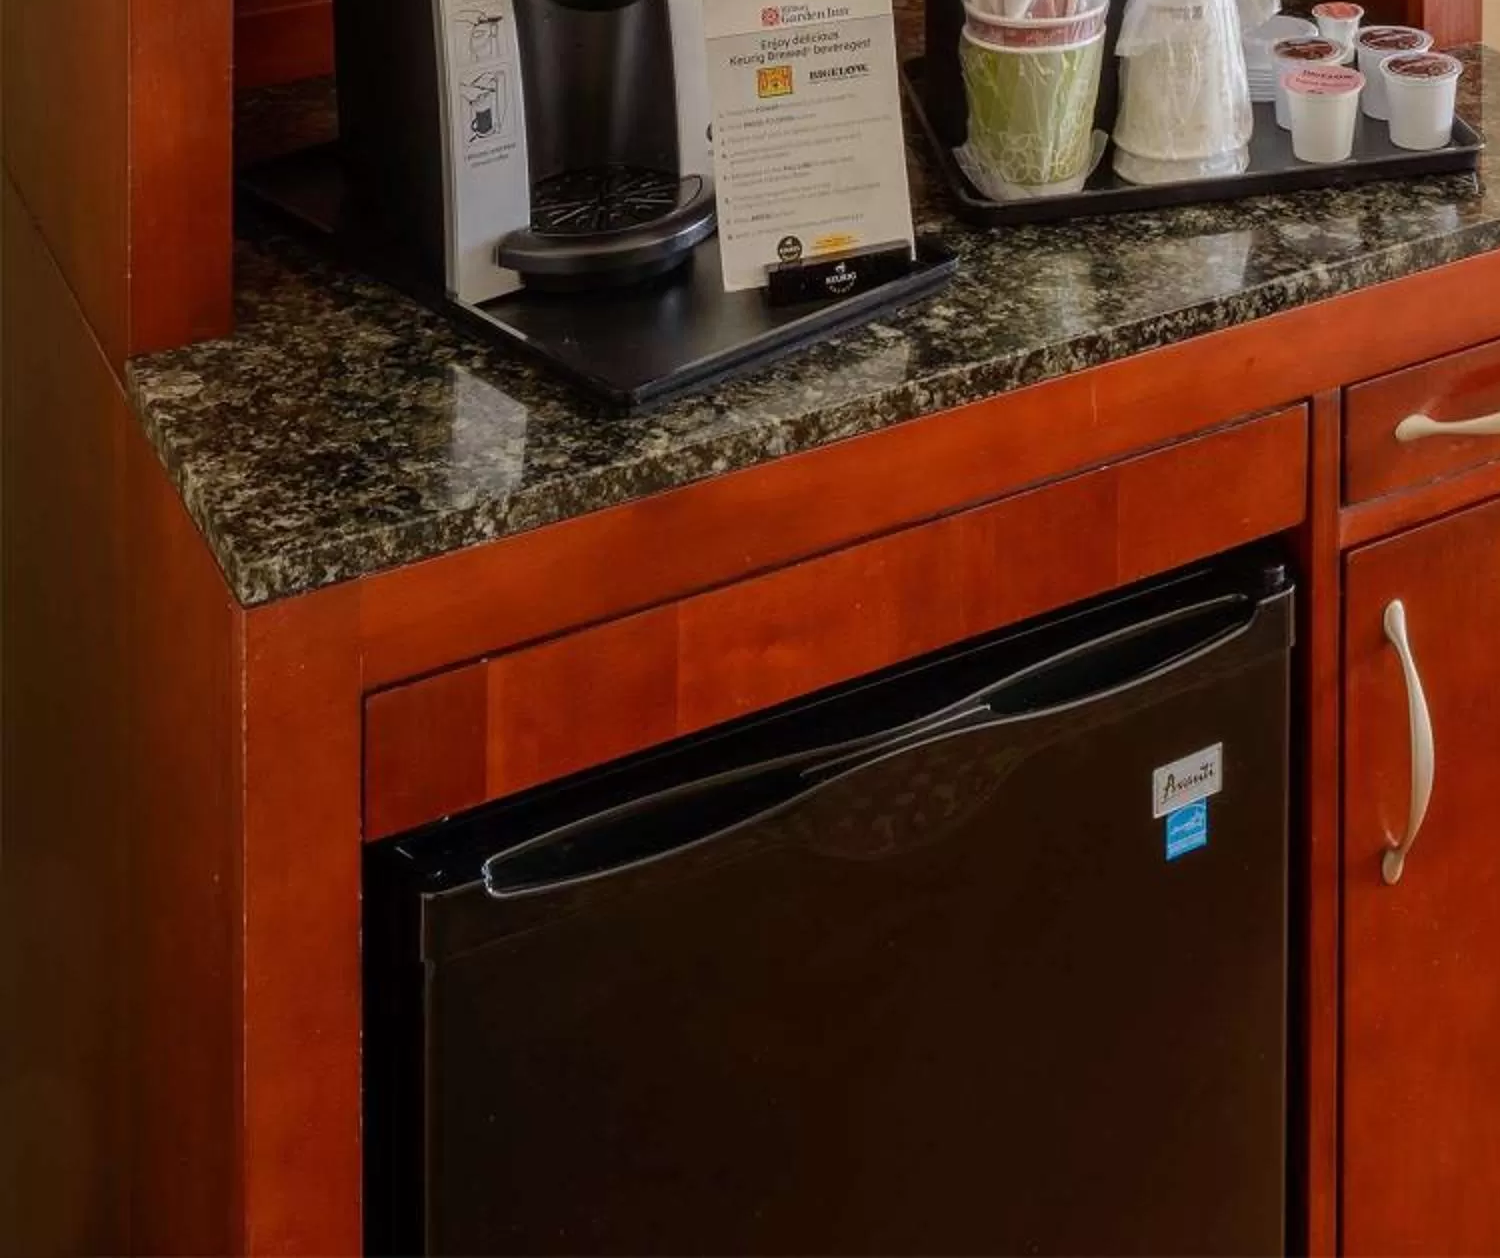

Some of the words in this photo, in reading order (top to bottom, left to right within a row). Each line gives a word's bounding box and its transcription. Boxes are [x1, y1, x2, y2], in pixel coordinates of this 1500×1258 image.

[781, 9, 825, 24] Garden
[760, 38, 790, 52] Enjoy
[791, 31, 840, 46] delicious
[729, 54, 765, 66] Keurig
[1160, 761, 1214, 804] Avanti
